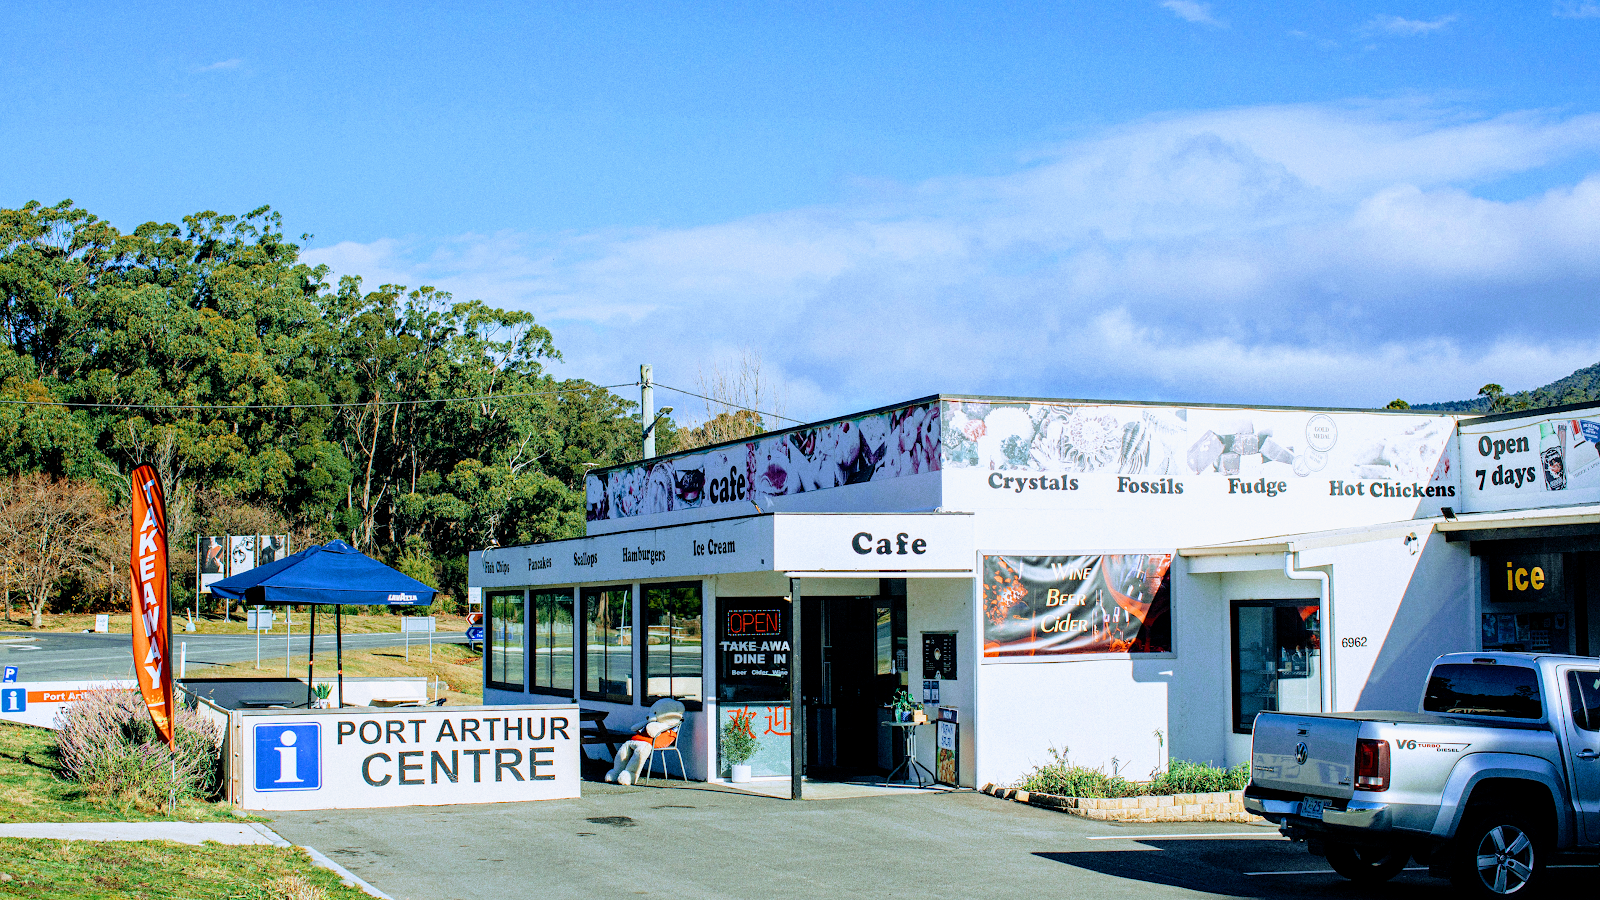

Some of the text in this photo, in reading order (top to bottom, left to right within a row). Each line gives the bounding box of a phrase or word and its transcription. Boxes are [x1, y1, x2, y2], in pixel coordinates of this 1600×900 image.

[1478, 435, 1530, 460] Open
[709, 465, 746, 504] cafe
[987, 472, 1079, 493] Crystals
[1117, 476, 1184, 494] Fossils
[1475, 464, 1536, 490] 7 days
[1227, 477, 1288, 497] Fudge
[1328, 480, 1456, 498] Hot Chickens
[693, 538, 736, 556] Ice Cream
[851, 531, 927, 555] Cafe
[527, 556, 552, 571] Pancakes
[573, 551, 598, 567] Scallops
[622, 546, 666, 565] Hamburgers
[484, 560, 510, 575] Fish Chips
[1506, 561, 1545, 591] ice
[138, 478, 163, 690] TAKEAWAY
[387, 592, 418, 601] LAVAZZA
[730, 612, 778, 633] OPEN
[721, 640, 791, 652] TAKE AWA
[1341, 636, 1368, 648] 6962
[733, 653, 787, 664] DINE IN
[5, 668, 16, 679] P
[43, 692, 65, 701] Port
[337, 716, 571, 745] PORT ARTHUR
[1395, 739, 1417, 750] V6
[361, 746, 556, 788] CENTRE
